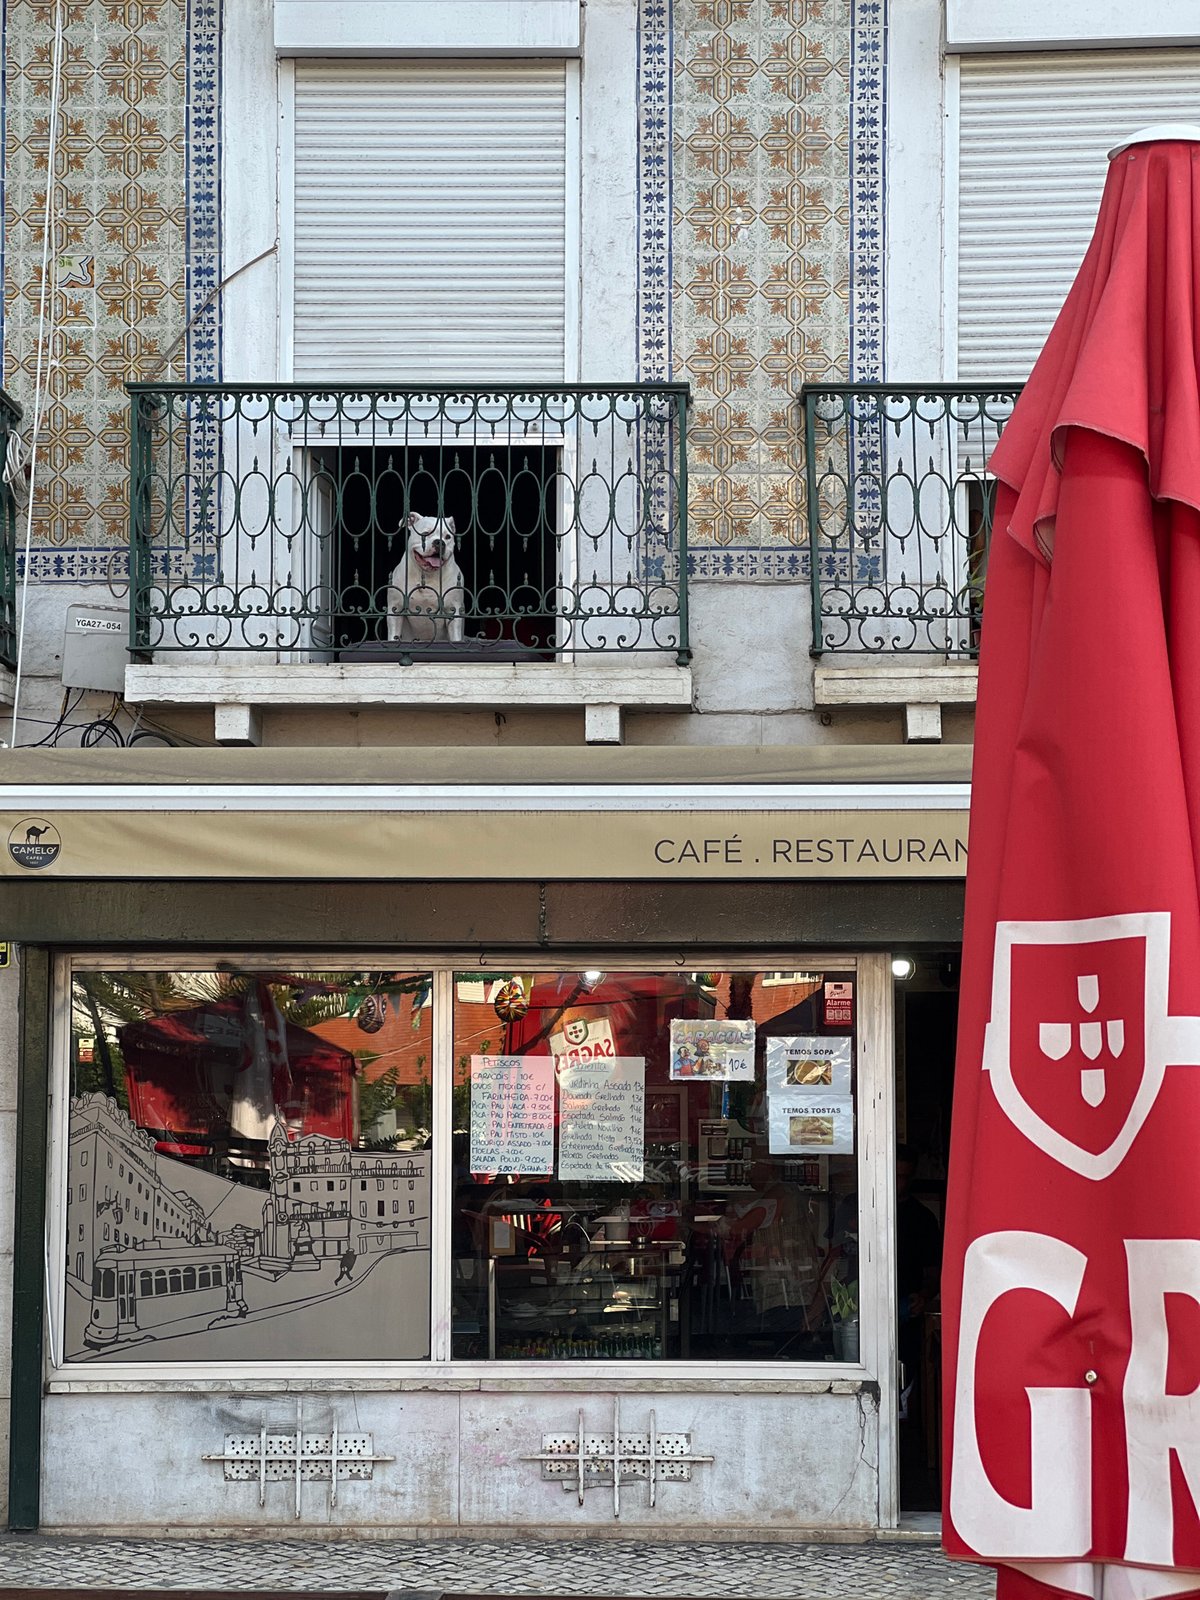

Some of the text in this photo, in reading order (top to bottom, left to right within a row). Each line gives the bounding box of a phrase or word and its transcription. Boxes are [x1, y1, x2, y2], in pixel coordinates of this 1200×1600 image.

[76, 619, 121, 630] YGA27-054
[12, 846, 57, 855] CAMELO
[654, 834, 743, 864] CAFÉ
[785, 1048, 834, 1056] TEMOS SOPA
